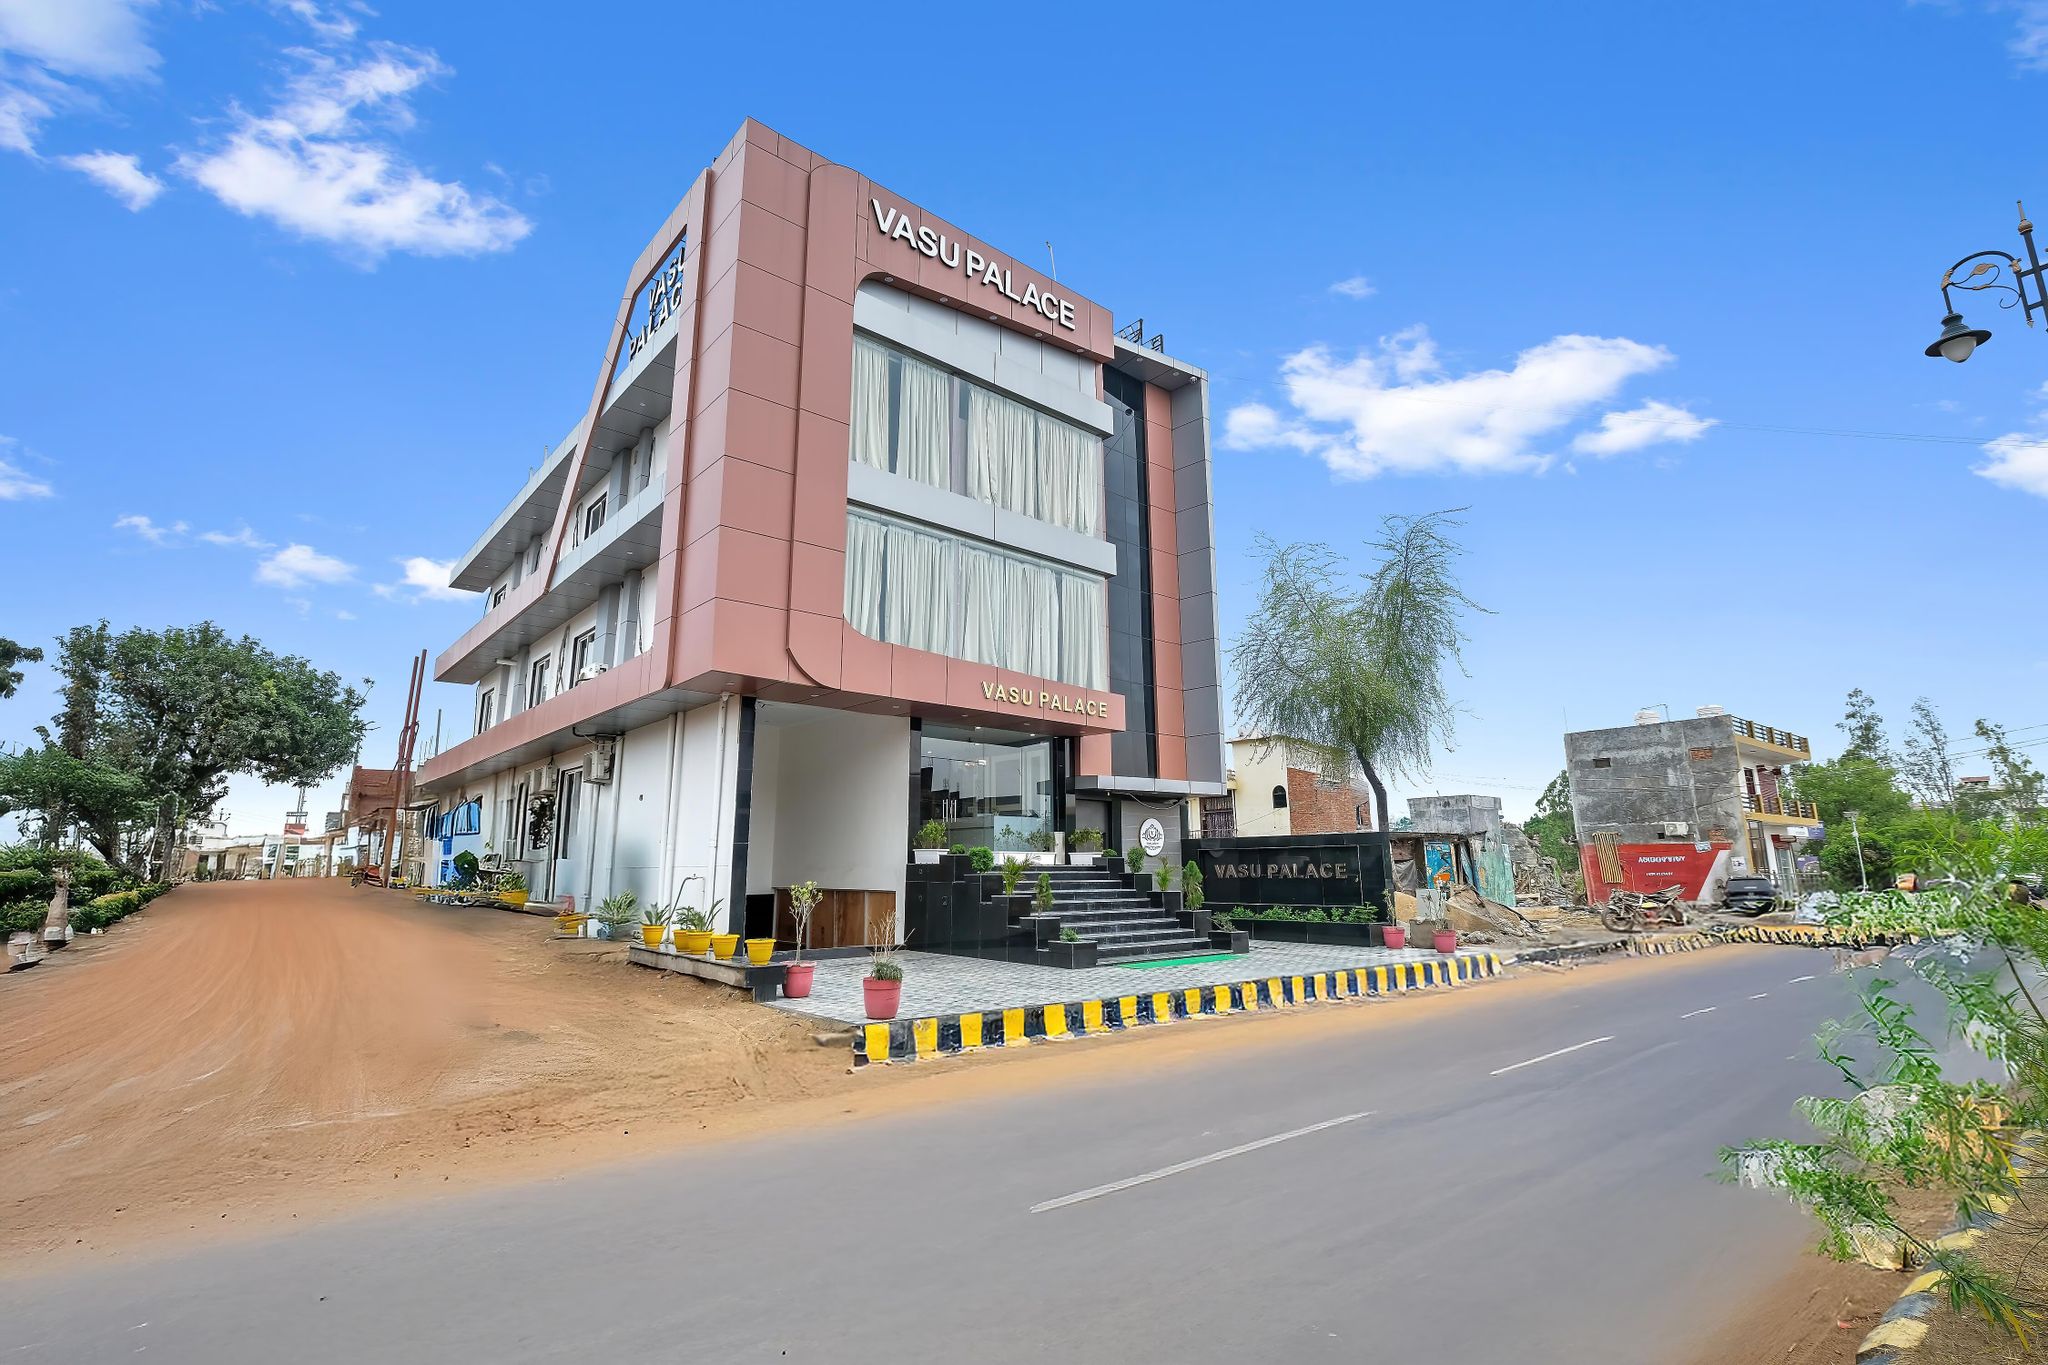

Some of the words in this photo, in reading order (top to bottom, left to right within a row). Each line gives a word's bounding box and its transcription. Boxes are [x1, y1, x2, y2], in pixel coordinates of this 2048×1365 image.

[871, 198, 960, 269] VASU
[966, 248, 1076, 331] PALACE
[981, 680, 1033, 706] VASU
[1039, 691, 1108, 718] PALACE
[1214, 863, 1261, 879] VASU
[1267, 863, 1348, 879] PALACE
